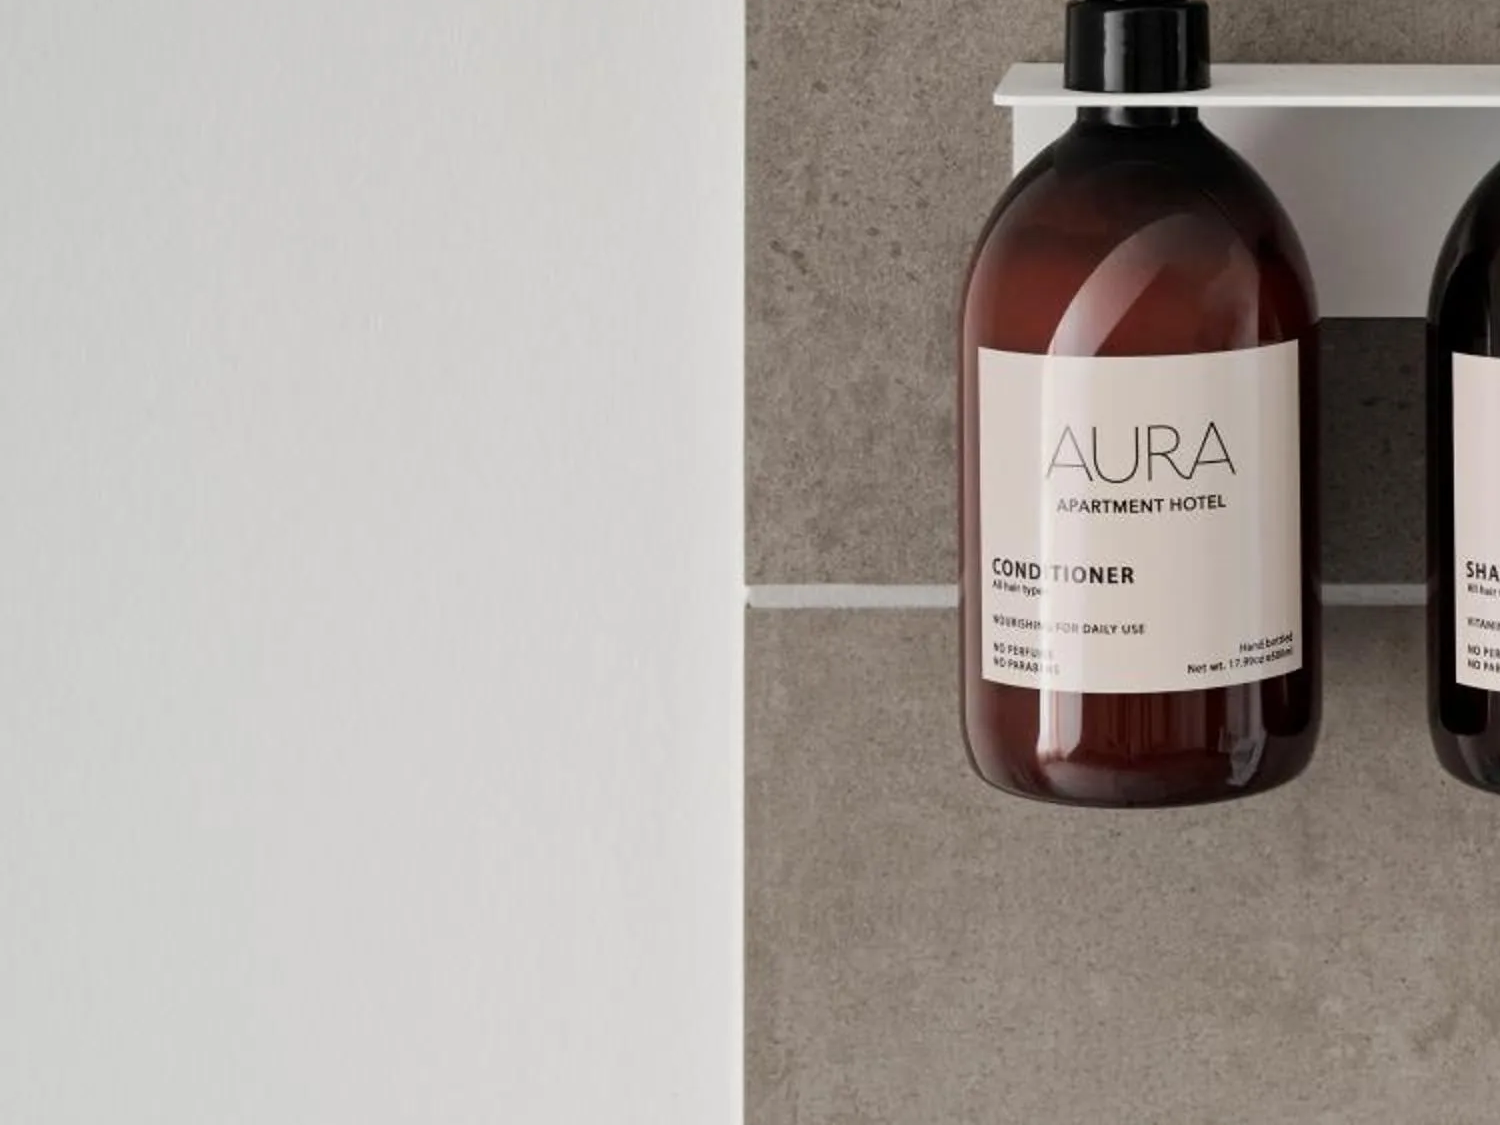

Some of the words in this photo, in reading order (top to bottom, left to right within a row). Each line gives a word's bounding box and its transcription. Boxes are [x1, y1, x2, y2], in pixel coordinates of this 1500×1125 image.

[1046, 421, 1236, 483] AURA
[1056, 498, 1164, 514] APARTMENT
[1169, 494, 1227, 512] HOTEL
[992, 557, 1135, 584] CONDITIONER
[1022, 584, 1049, 597] type
[993, 614, 1052, 632] NOURISHIN
[1056, 623, 1079, 634] FOR
[1082, 624, 1118, 635] DAILY
[1121, 624, 1145, 635] USE
[1008, 644, 1054, 660] PERFU
[1467, 644, 1481, 656] NO
[1008, 659, 1060, 675] PARABNS
[1187, 663, 1207, 674] Net
[1467, 658, 1481, 671] NO
